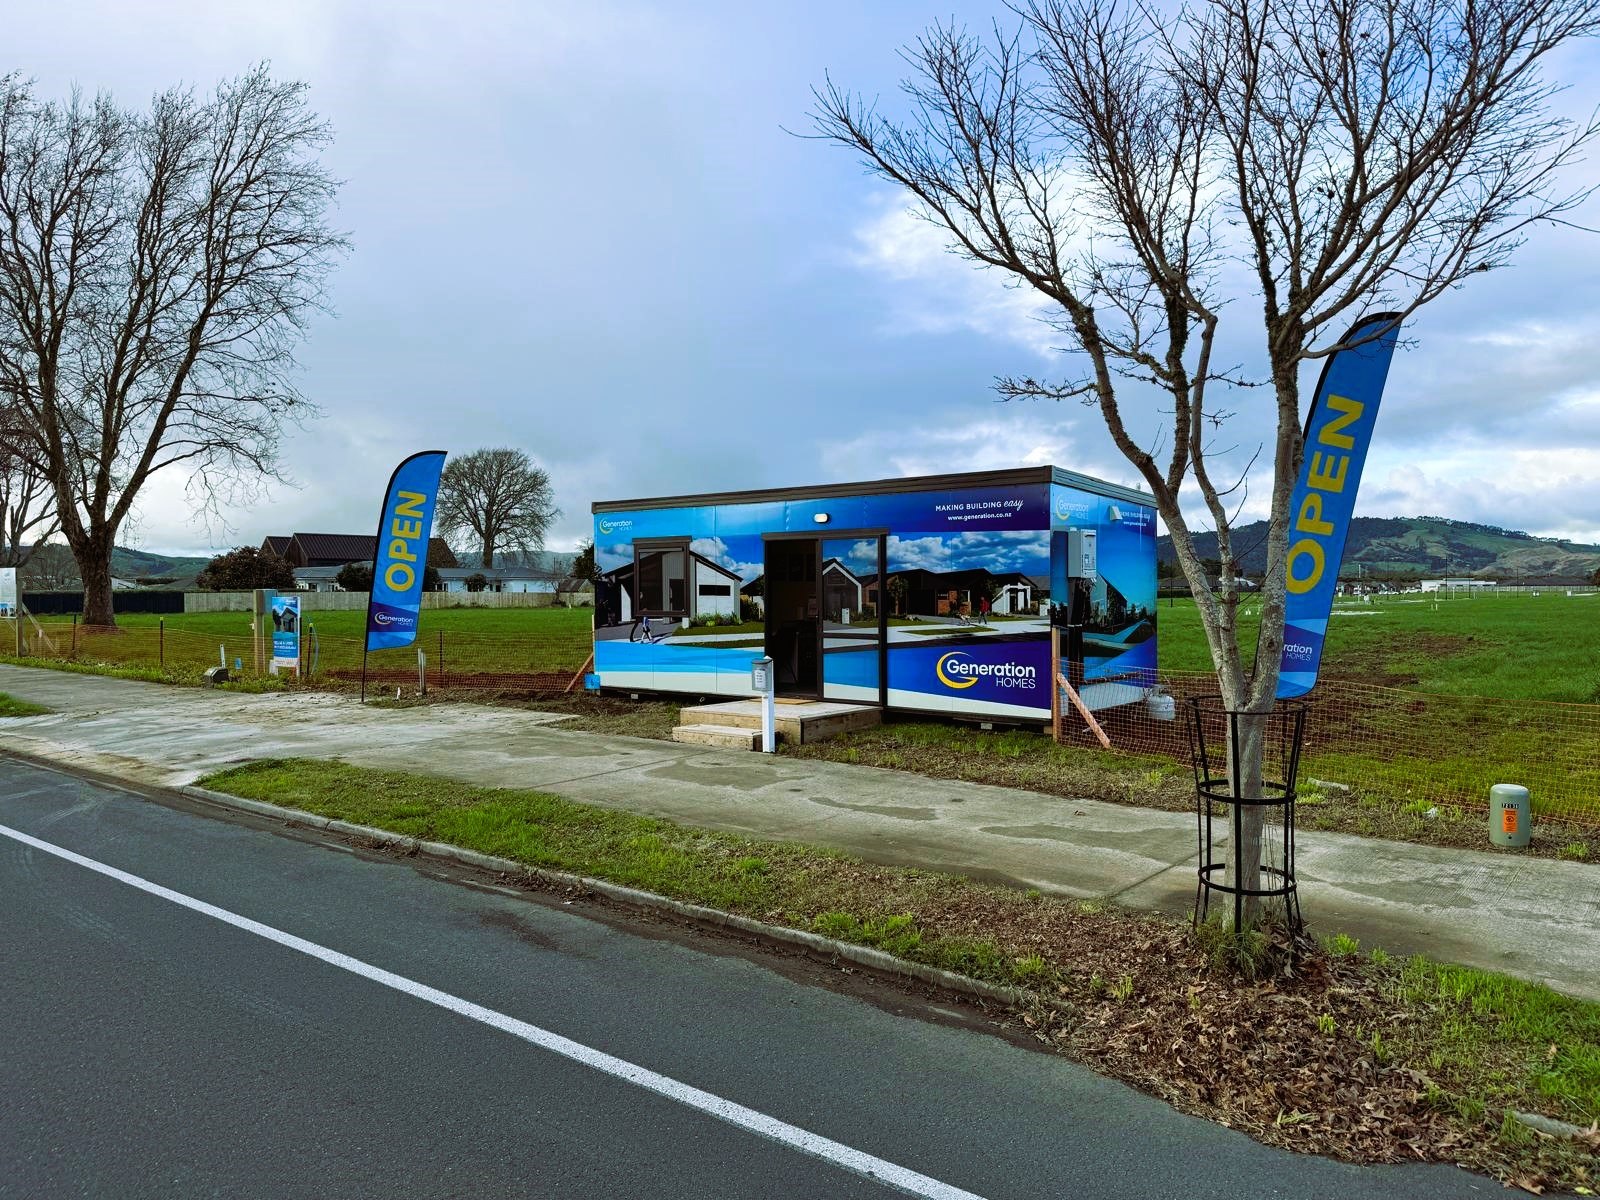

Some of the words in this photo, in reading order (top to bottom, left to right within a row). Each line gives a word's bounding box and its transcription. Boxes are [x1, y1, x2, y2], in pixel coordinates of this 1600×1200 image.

[1286, 394, 1365, 594] OPEN
[935, 503, 965, 512] MAKING
[966, 501, 1002, 510] BUILDING
[1003, 499, 1024, 511] easy
[947, 512, 1012, 522] www.generation.co.nz
[602, 520, 633, 528] Generation
[384, 490, 427, 592] OPEN
[378, 613, 413, 623] Generation
[1283, 643, 1312, 654] ration
[1286, 652, 1311, 661] HOMES
[946, 659, 1036, 678] Generation
[996, 677, 1036, 689] HOMES
